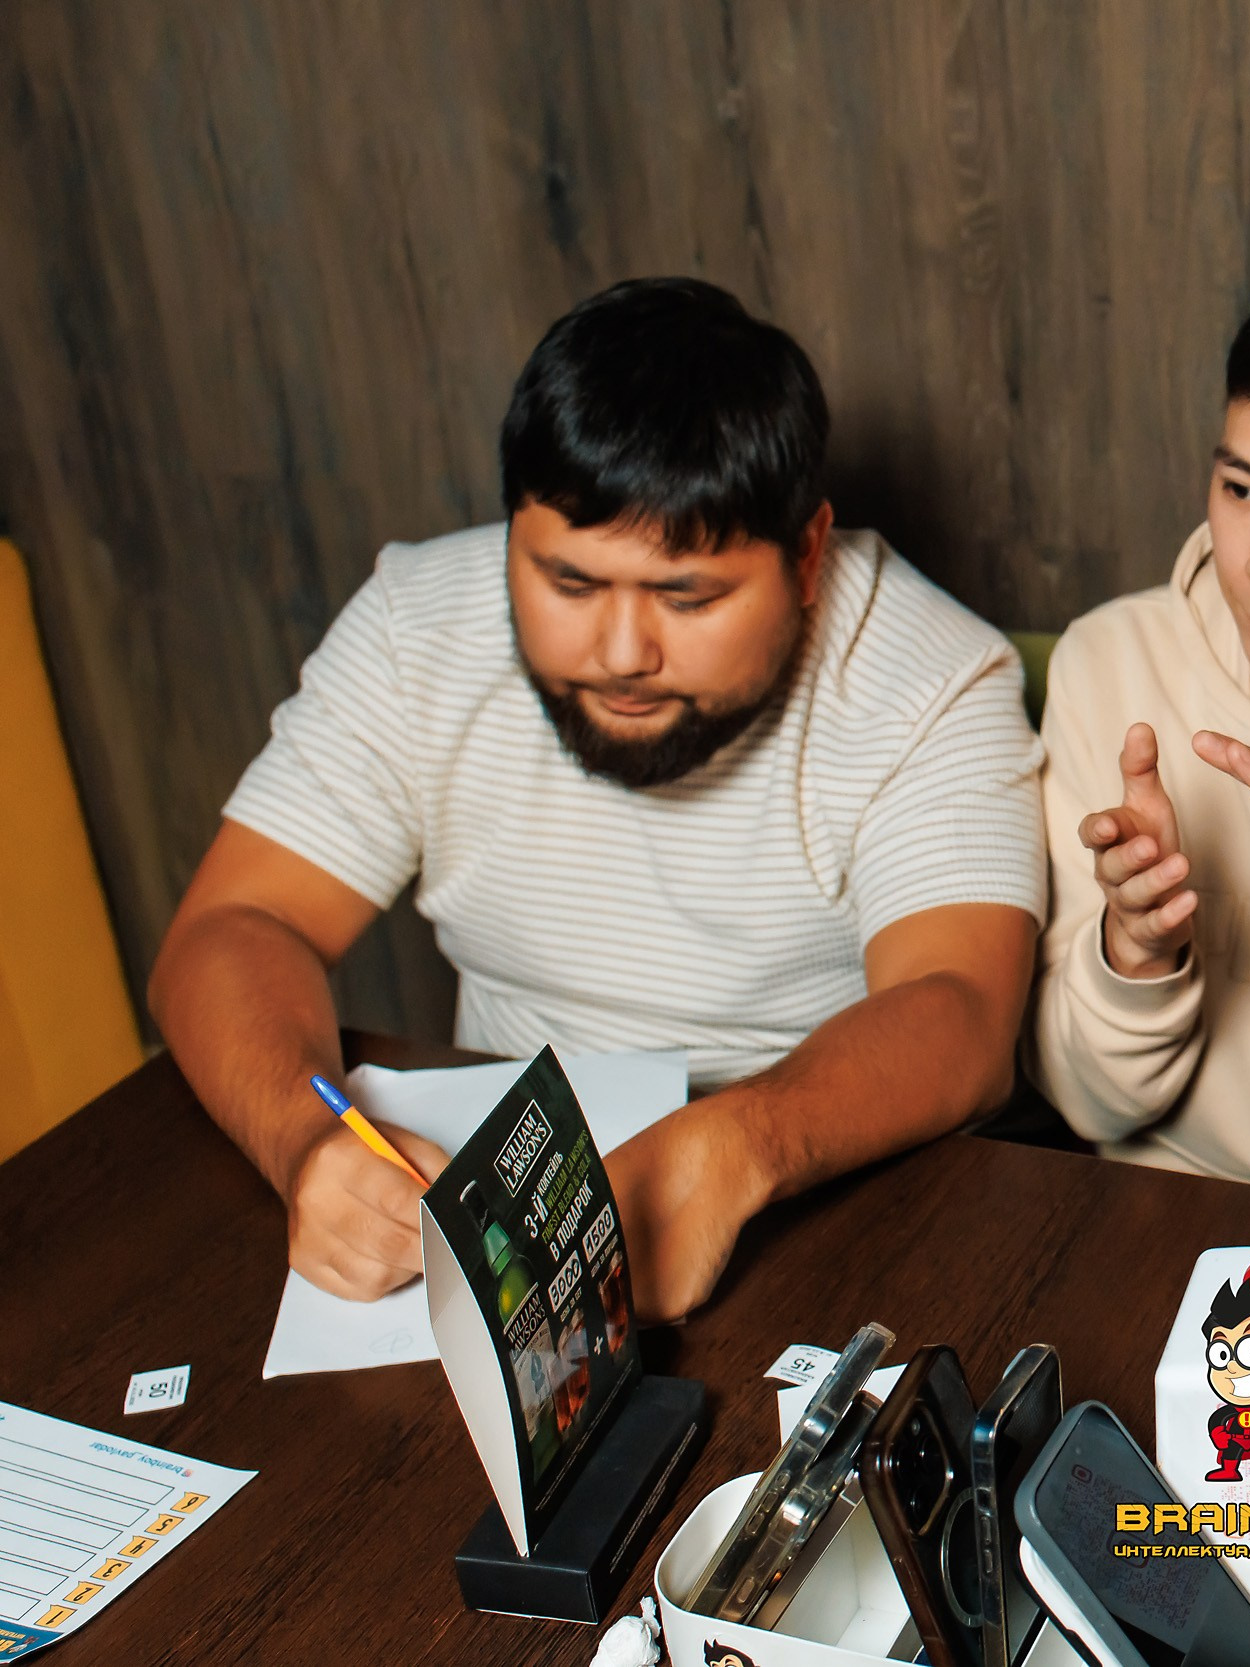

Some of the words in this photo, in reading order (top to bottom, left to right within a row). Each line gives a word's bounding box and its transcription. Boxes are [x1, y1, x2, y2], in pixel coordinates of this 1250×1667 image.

[499, 1112, 538, 1170] WILLIAM
[506, 1122, 547, 1190] LAWSON'S
[536, 1151, 564, 1197] КОКТЕЙЛЬ
[544, 1168, 569, 1210] WILLIAM
[524, 1191, 549, 1239] 3-Й
[541, 1209, 561, 1244] FINEST
[557, 1183, 576, 1214] BLEND
[585, 1210, 612, 1256] 1500
[549, 1241, 560, 1262] В
[550, 1258, 580, 1306] 3000
[507, 1292, 541, 1343] WILLIAM
[790, 1358, 815, 1372] 45
[149, 1382, 167, 1398] 50
[180, 1496, 199, 1510] 6
[155, 1518, 173, 1532] 5
[129, 1539, 146, 1555] 4
[102, 1562, 122, 1578] 3
[73, 1586, 93, 1602] 2
[45, 1610, 64, 1625] 1
